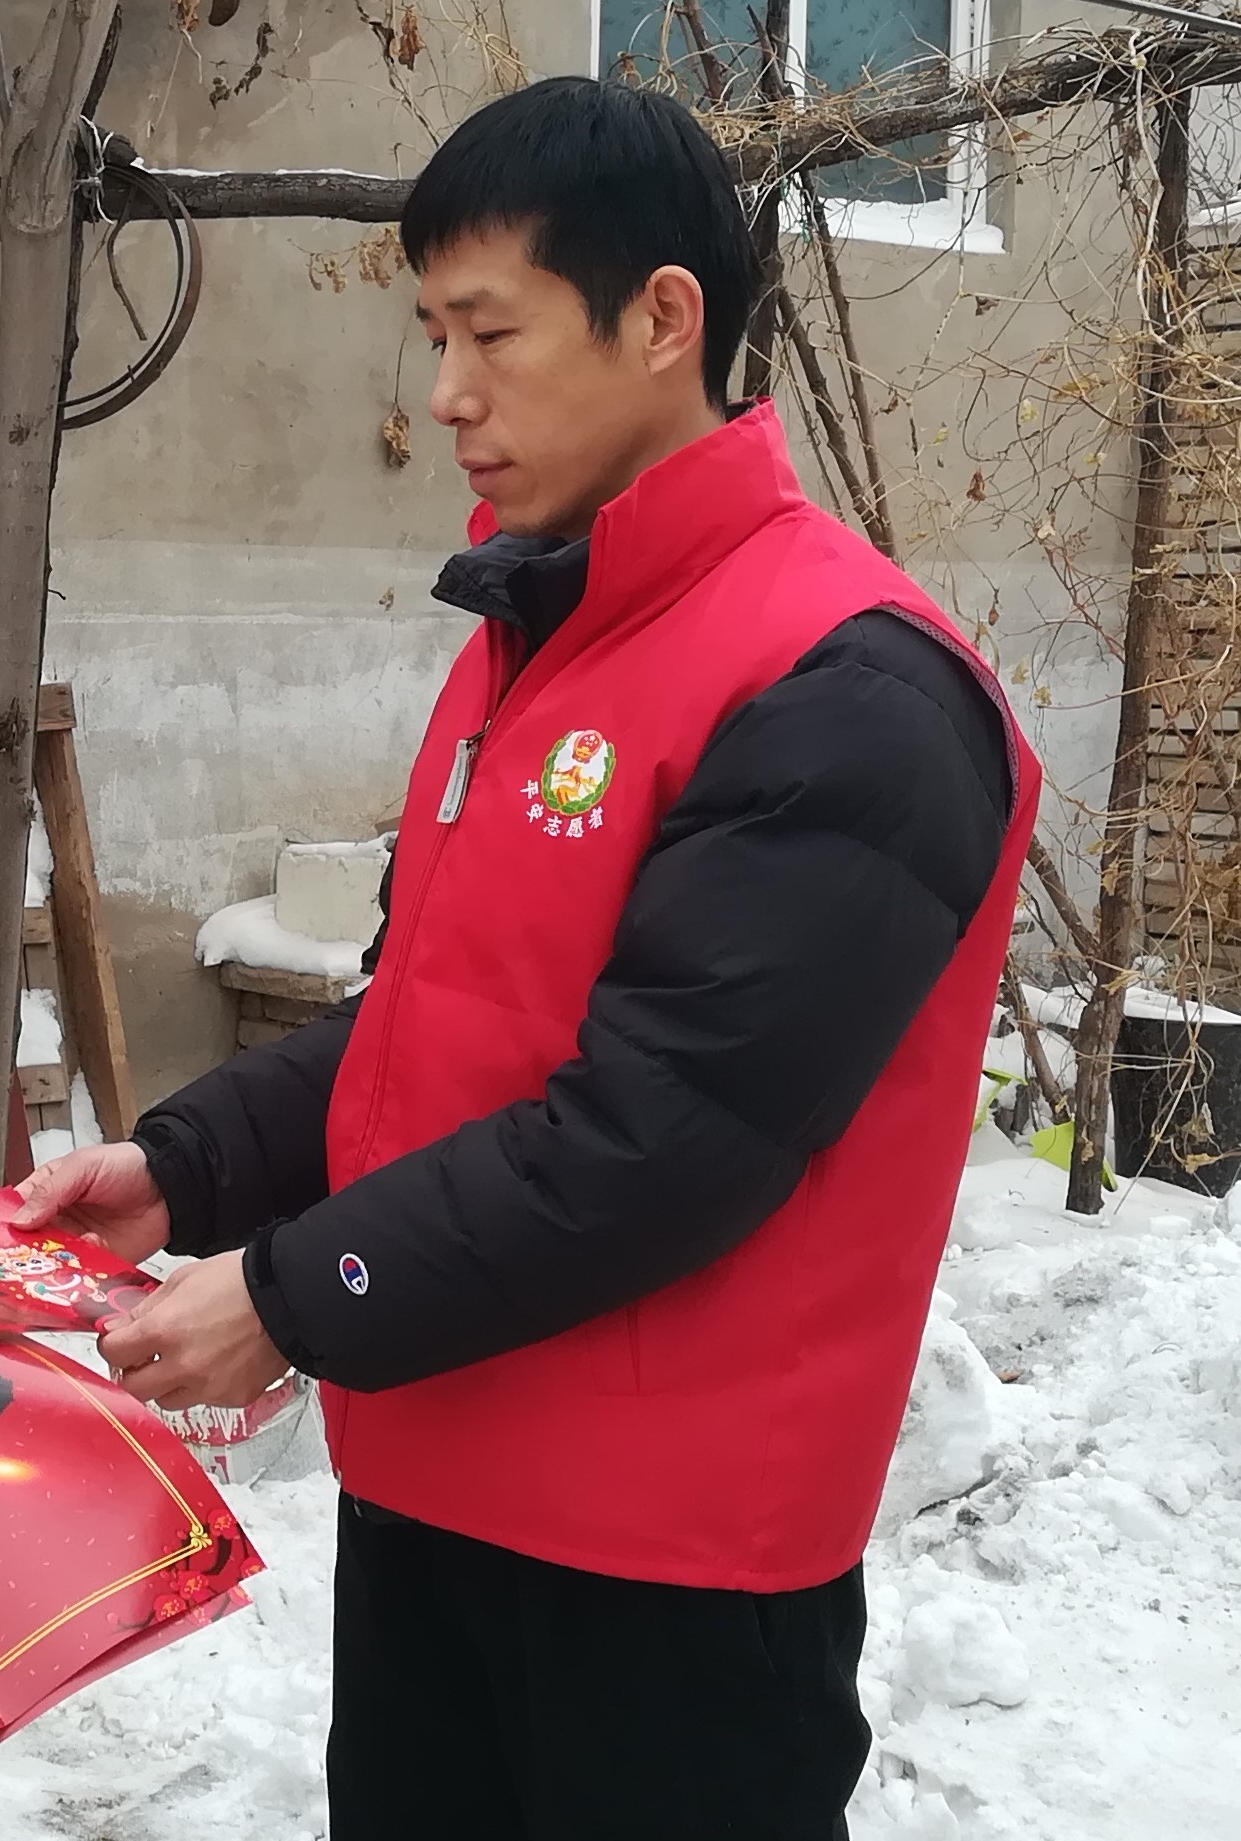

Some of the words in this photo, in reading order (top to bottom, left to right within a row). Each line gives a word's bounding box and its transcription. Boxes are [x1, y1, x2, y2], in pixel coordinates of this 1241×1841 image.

[520, 779, 604, 838] 平安志愿者
